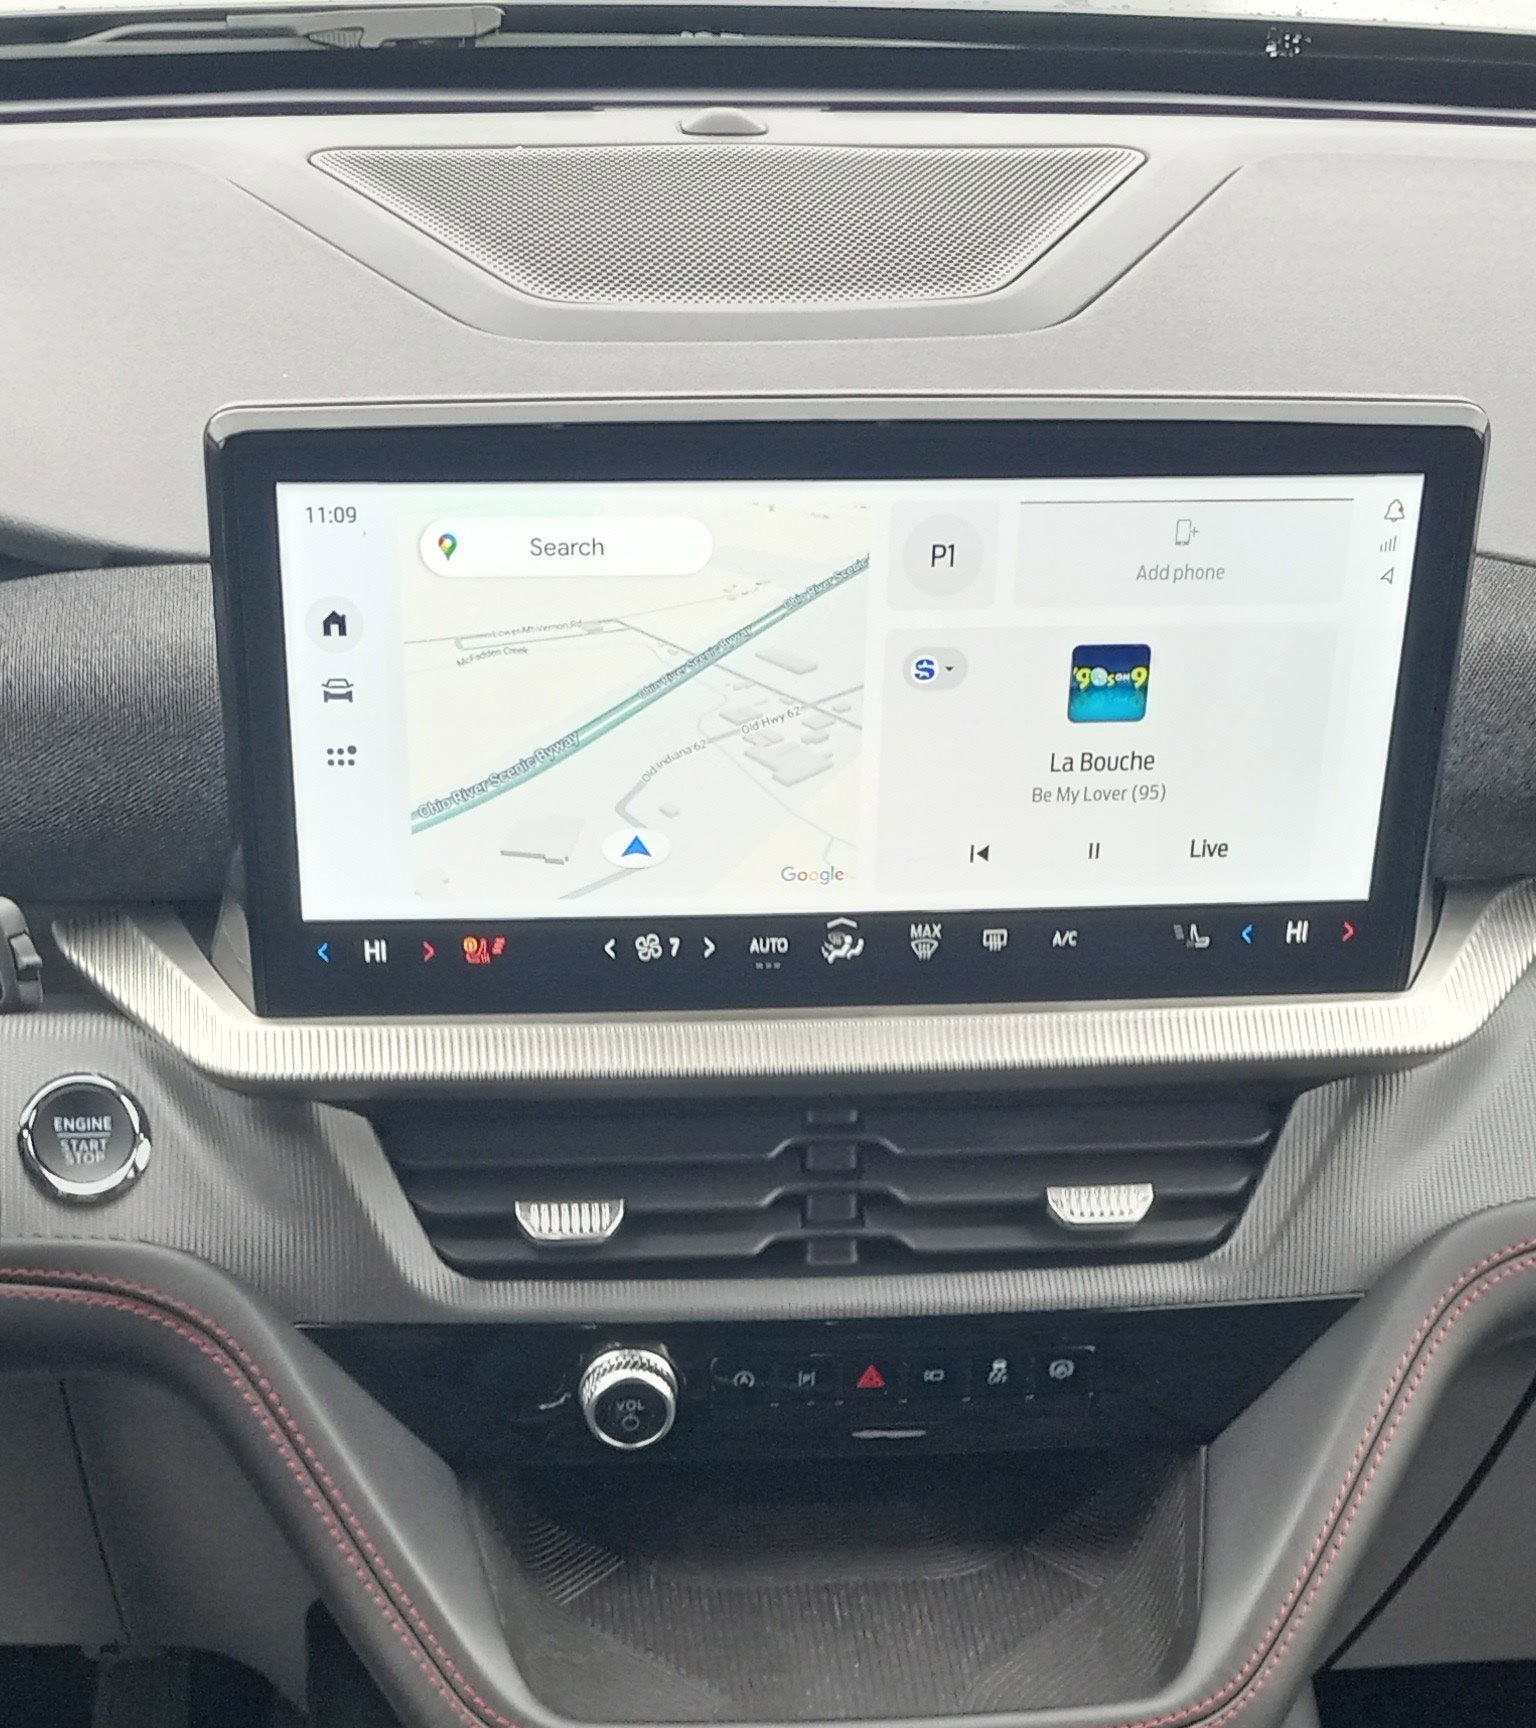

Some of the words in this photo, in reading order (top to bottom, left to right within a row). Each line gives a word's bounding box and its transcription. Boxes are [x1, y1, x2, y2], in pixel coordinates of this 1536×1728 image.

[305, 506, 357, 524] 11:09
[530, 537, 605, 557] Search
[931, 544, 956, 568] P1
[1136, 565, 1169, 582] Add
[1172, 564, 1225, 584] phone
[740, 720, 760, 735] Old
[761, 713, 786, 730] Hwy
[786, 706, 802, 720] 62
[642, 763, 658, 783] Old
[656, 745, 693, 769] Indiana
[692, 738, 708, 752] 62
[1050, 752, 1075, 773] La
[1080, 751, 1156, 773] Bouche
[417, 796, 453, 819] Ohio
[451, 778, 489, 805] River
[487, 755, 537, 787] Scenic
[533, 730, 581, 762] Byway
[1032, 787, 1052, 803] Be
[1056, 786, 1081, 806] My
[1083, 785, 1128, 802] Lover
[1132, 783, 1167, 804] (95)
[1189, 838, 1229, 859] Live
[781, 866, 845, 886] Google
[910, 923, 942, 939] MAX
[1052, 930, 1078, 948] A/C
[1285, 920, 1310, 944] HI
[364, 939, 388, 964] HI
[669, 937, 681, 957] 7
[749, 937, 790, 955] AUTO
[53, 1116, 112, 1132] ENGINE
[60, 1138, 108, 1153] START
[615, 1399, 645, 1411] VOL
